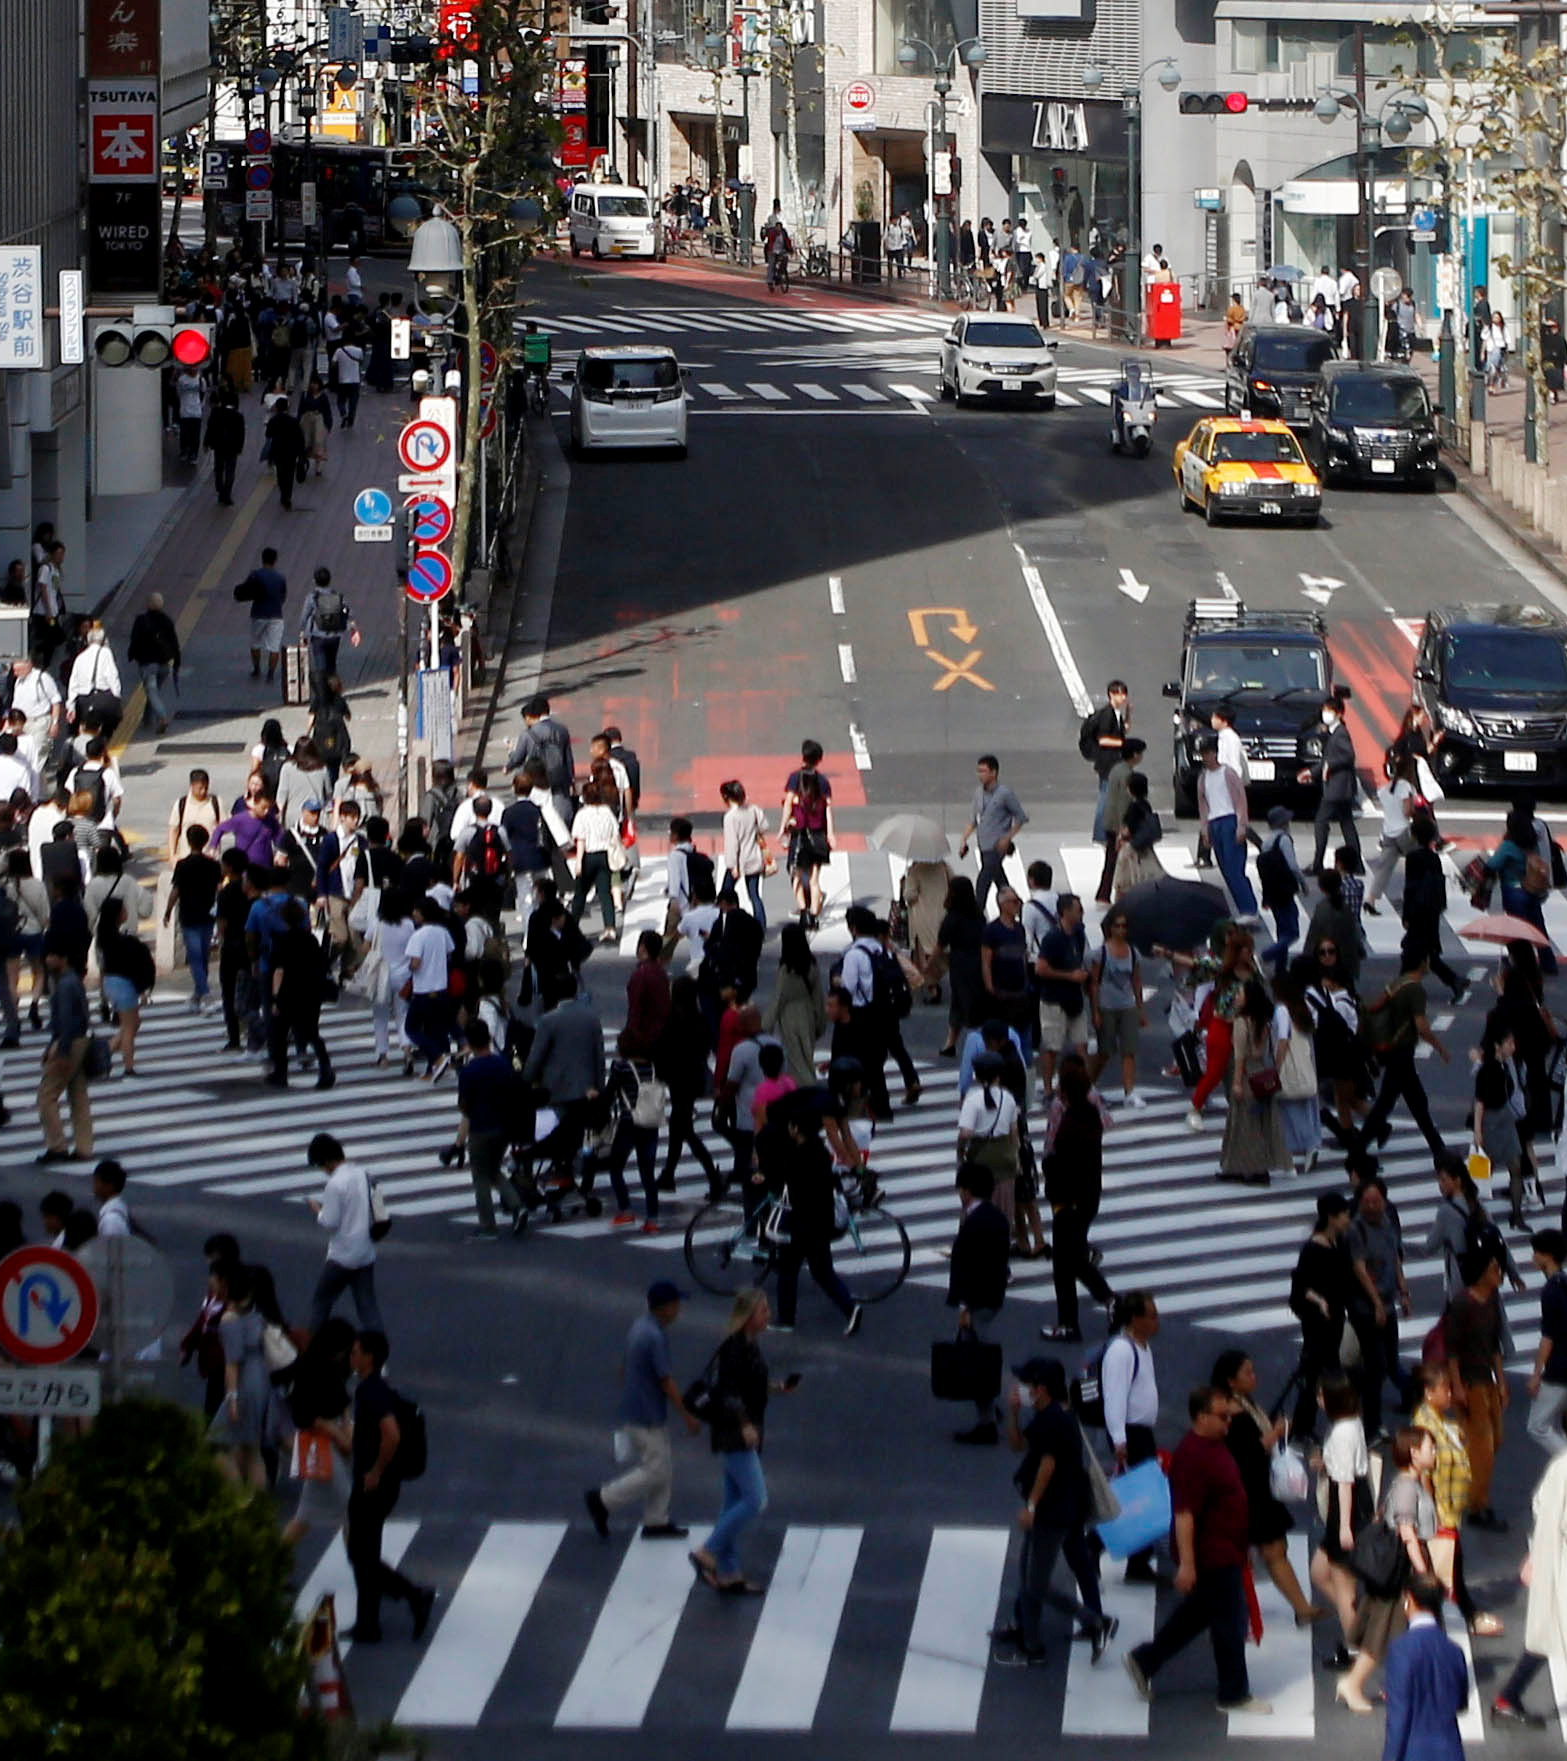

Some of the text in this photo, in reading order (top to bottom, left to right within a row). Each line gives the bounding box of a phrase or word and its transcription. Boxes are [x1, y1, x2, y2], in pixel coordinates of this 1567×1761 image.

[89, 90, 157, 104] TSUTAYA
[100, 121, 146, 168] 本
[1032, 101, 1089, 152] ZARA
[98, 225, 150, 240] WIRED
[11, 256, 34, 357] 渋谷駅前
